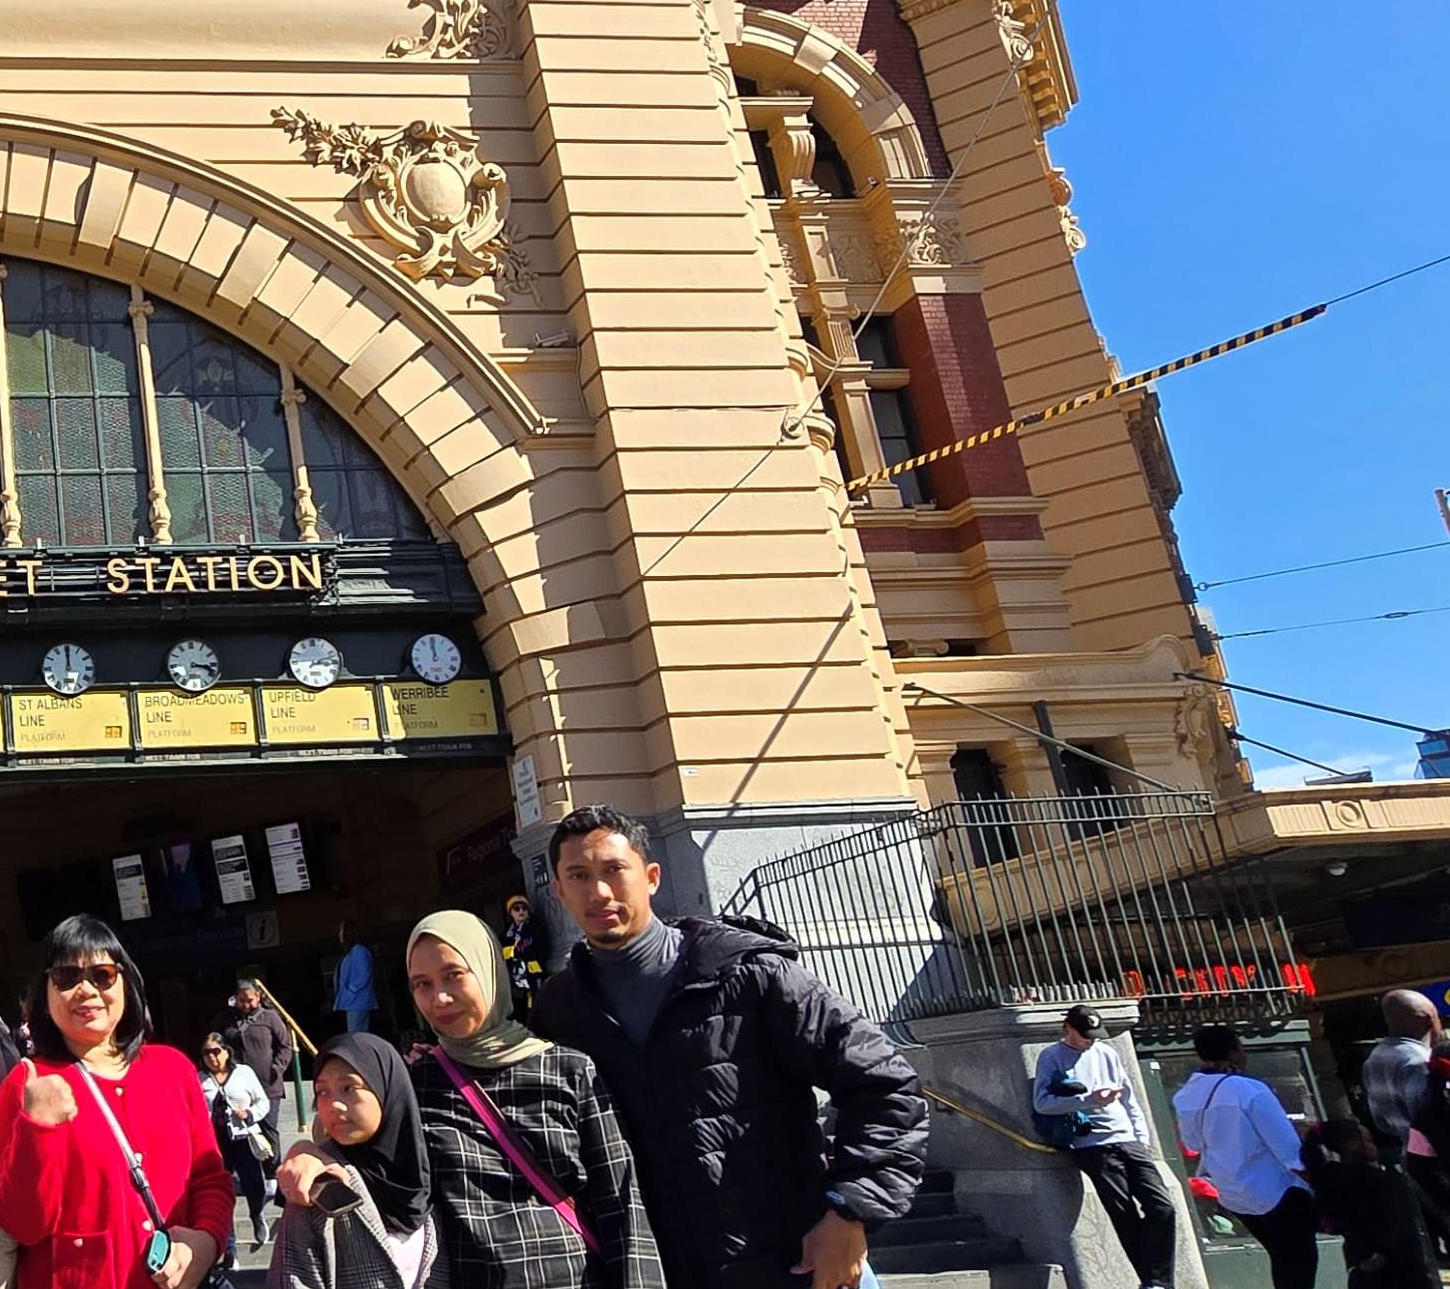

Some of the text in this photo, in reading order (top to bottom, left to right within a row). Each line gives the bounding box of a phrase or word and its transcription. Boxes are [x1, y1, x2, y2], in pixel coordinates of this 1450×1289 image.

[106, 554, 324, 596] STATION
[269, 690, 316, 703] UPFIELD
[392, 686, 449, 700] WERRIBEE
[19, 697, 83, 710] ST ALBANS
[144, 693, 245, 708] BROADMEADOWS
[147, 711, 172, 723] LINE
[271, 707, 296, 718] LINE
[20, 715, 45, 727] LINE
[148, 728, 192, 738] PLATFORM
[272, 724, 316, 734] PLATFORM
[21, 732, 66, 742] PLATFORM
